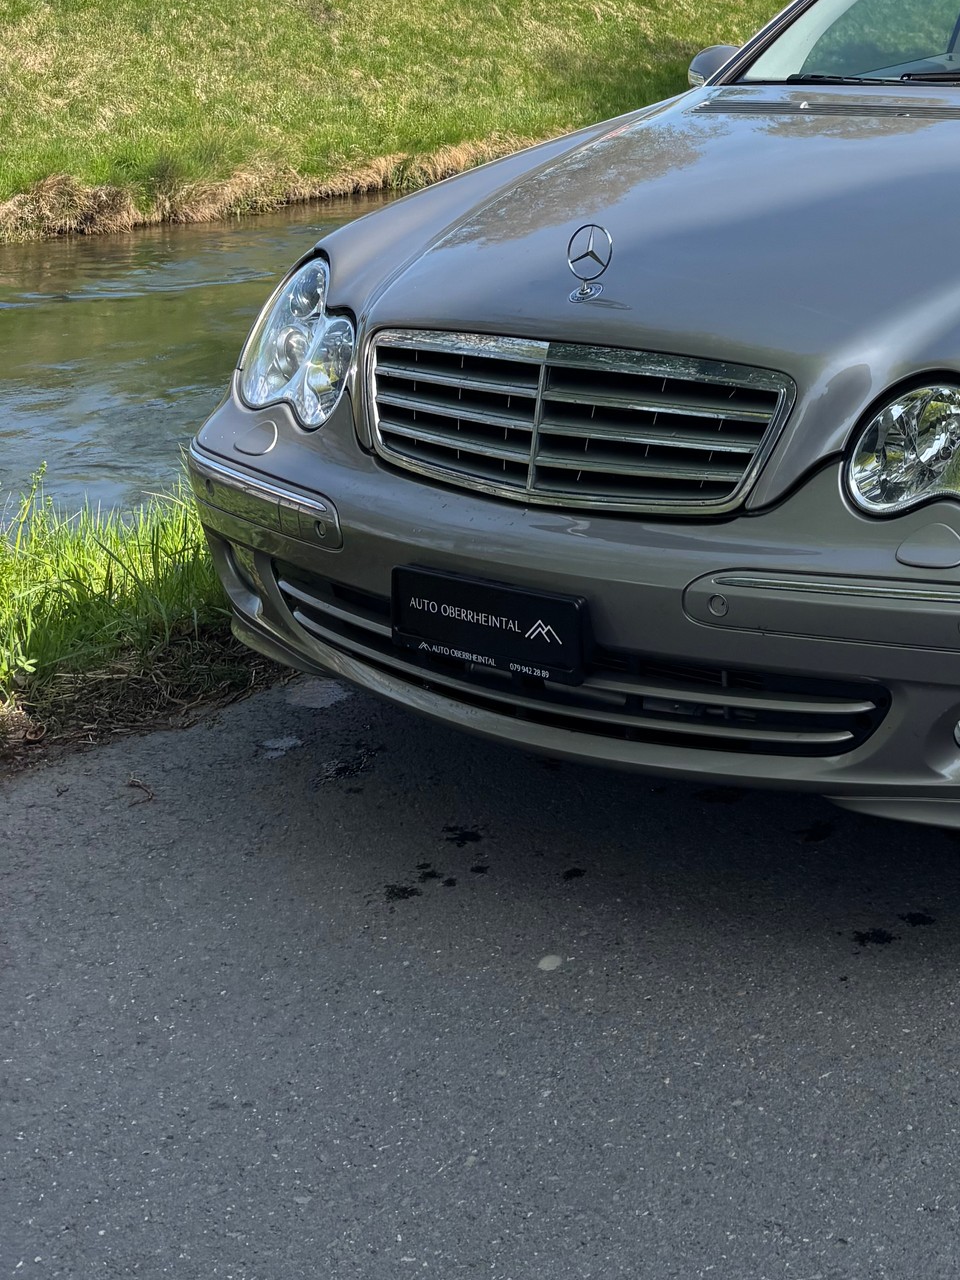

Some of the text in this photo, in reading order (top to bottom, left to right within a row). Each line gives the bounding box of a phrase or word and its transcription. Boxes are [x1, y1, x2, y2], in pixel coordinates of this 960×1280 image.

[409, 597, 521, 633] AUTO OBERRHEINTAL
[431, 645, 496, 666] AUTO OBERRHEINTAL
[509, 663, 521, 672] 079
[521, 665, 533, 675] 942
[533, 668, 541, 677] 28
